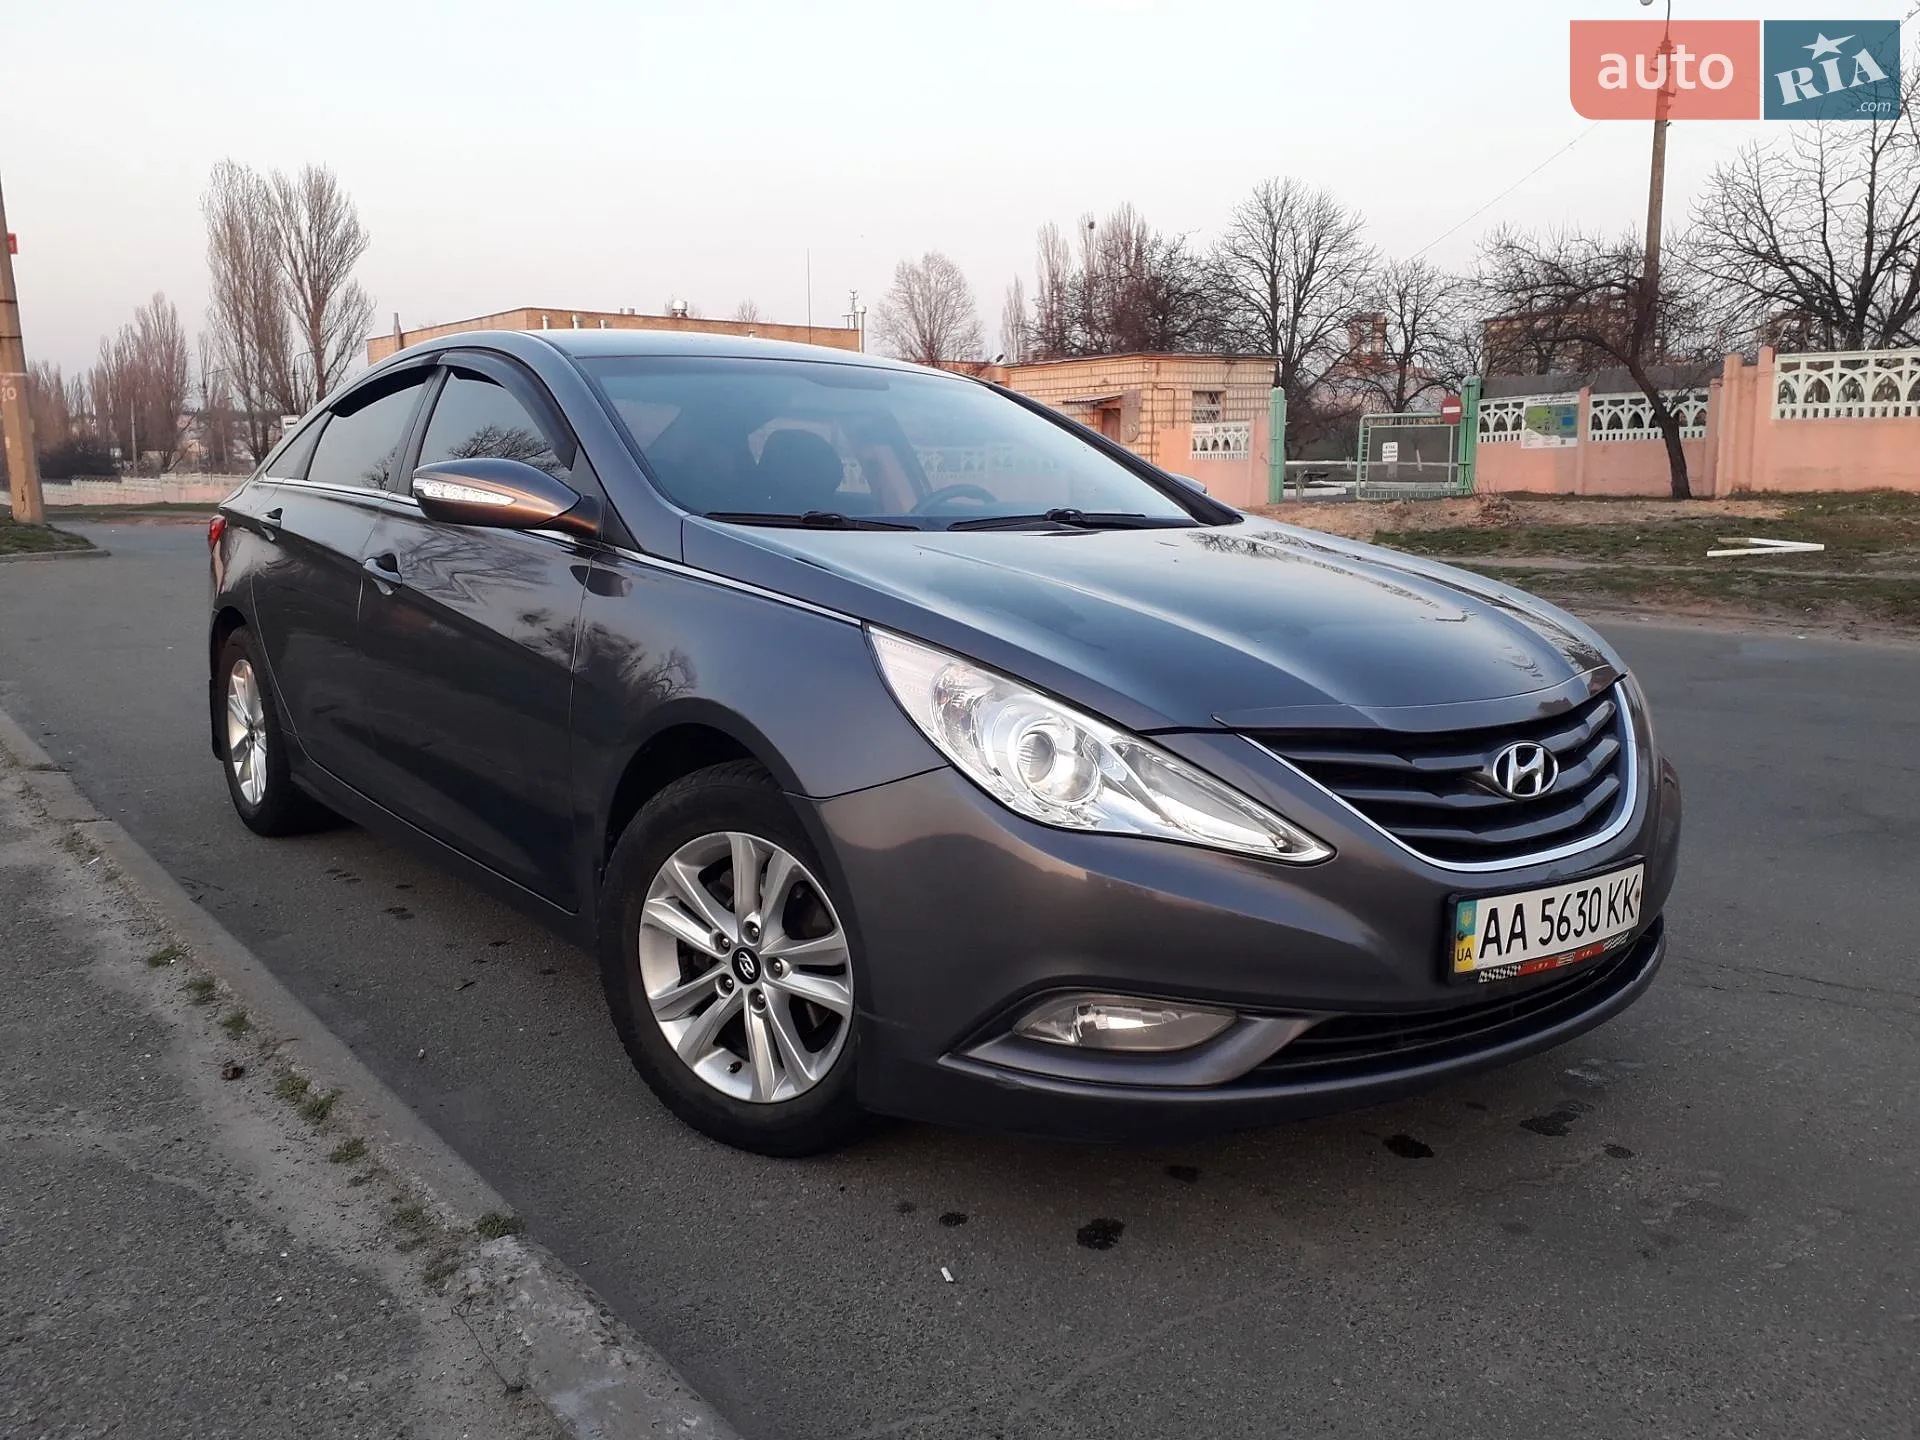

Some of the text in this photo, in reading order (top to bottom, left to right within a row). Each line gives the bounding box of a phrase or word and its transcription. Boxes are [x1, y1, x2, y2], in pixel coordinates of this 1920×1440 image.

[1478, 874, 1639, 959] AA 5630 KK
[1457, 948, 1472, 962] UA
